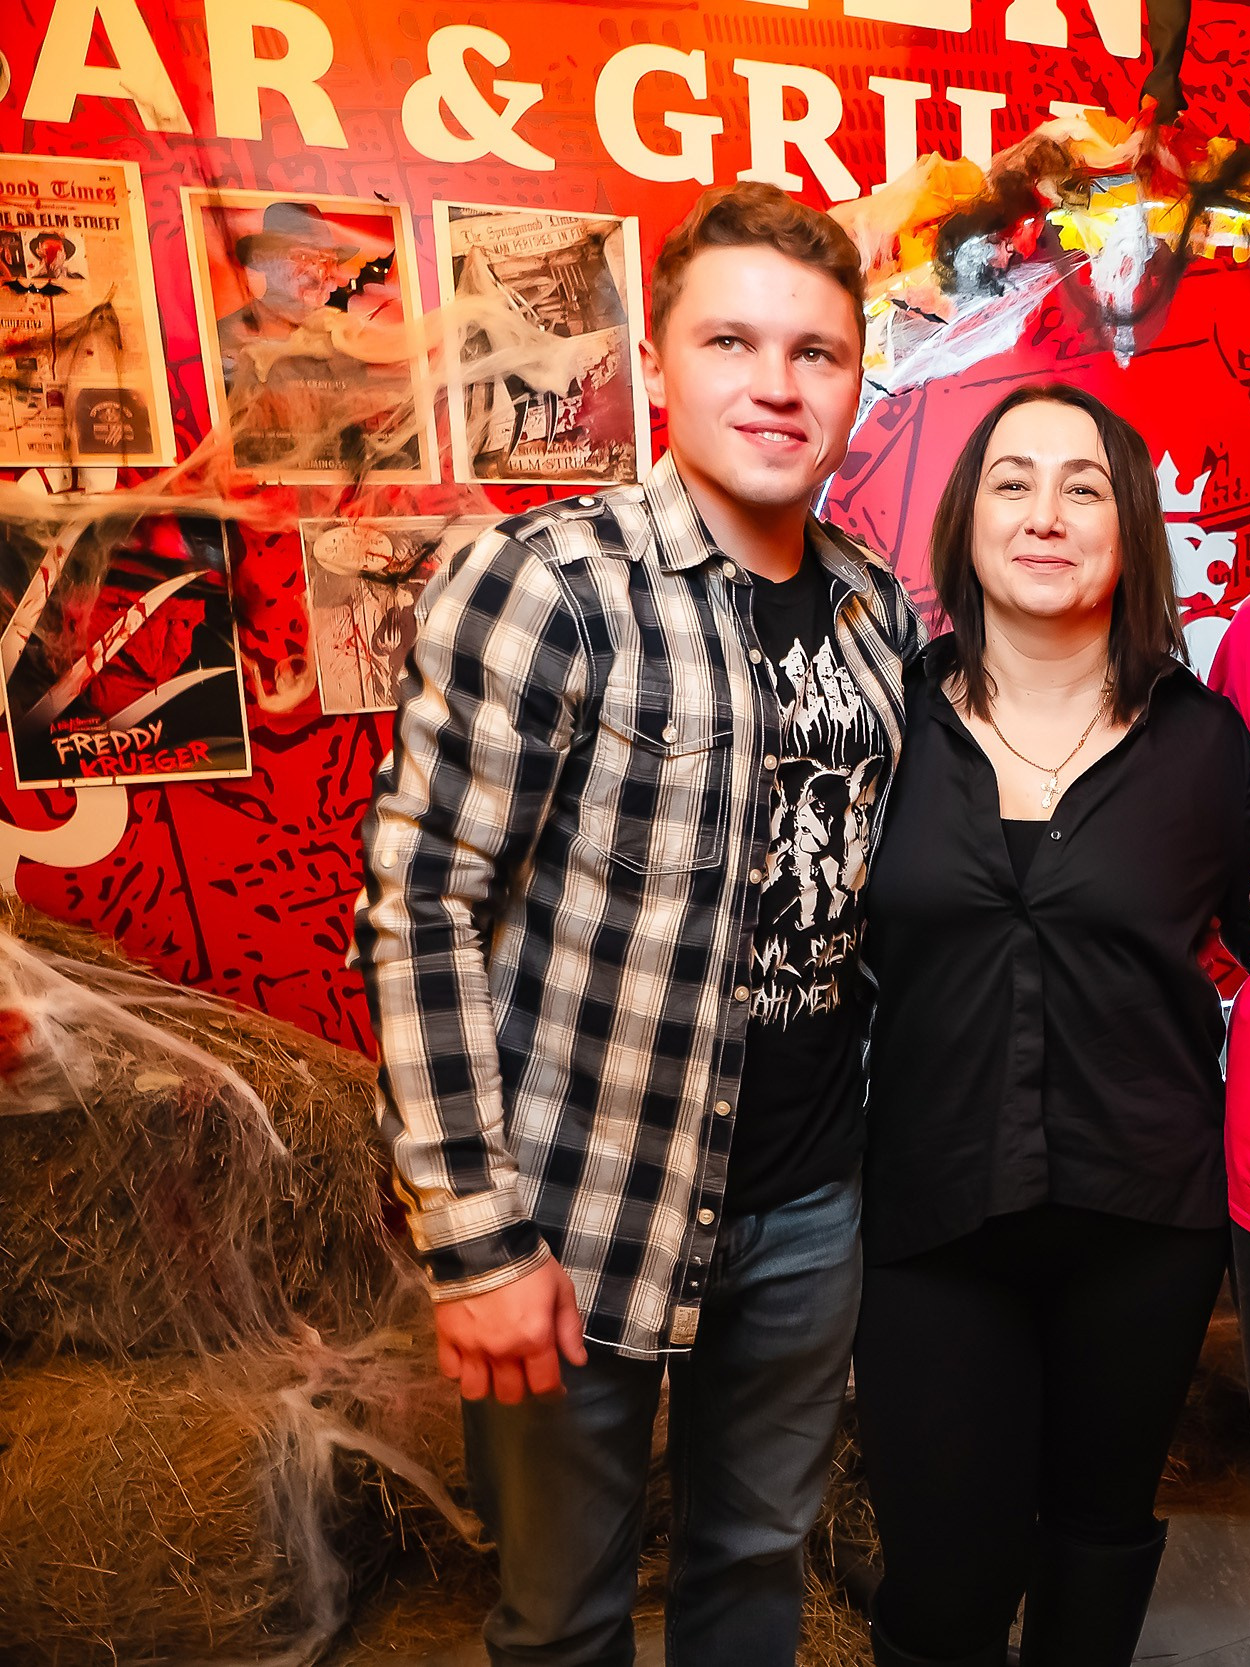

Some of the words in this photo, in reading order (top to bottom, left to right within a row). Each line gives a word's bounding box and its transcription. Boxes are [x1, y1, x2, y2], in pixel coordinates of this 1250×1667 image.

[0, 0, 349, 149] AR
[401, 24, 556, 171] &
[51, 180, 116, 201] Times
[73, 216, 120, 231] STREET
[52, 719, 163, 765] FREDDY
[79, 740, 213, 778] KRUEGER
